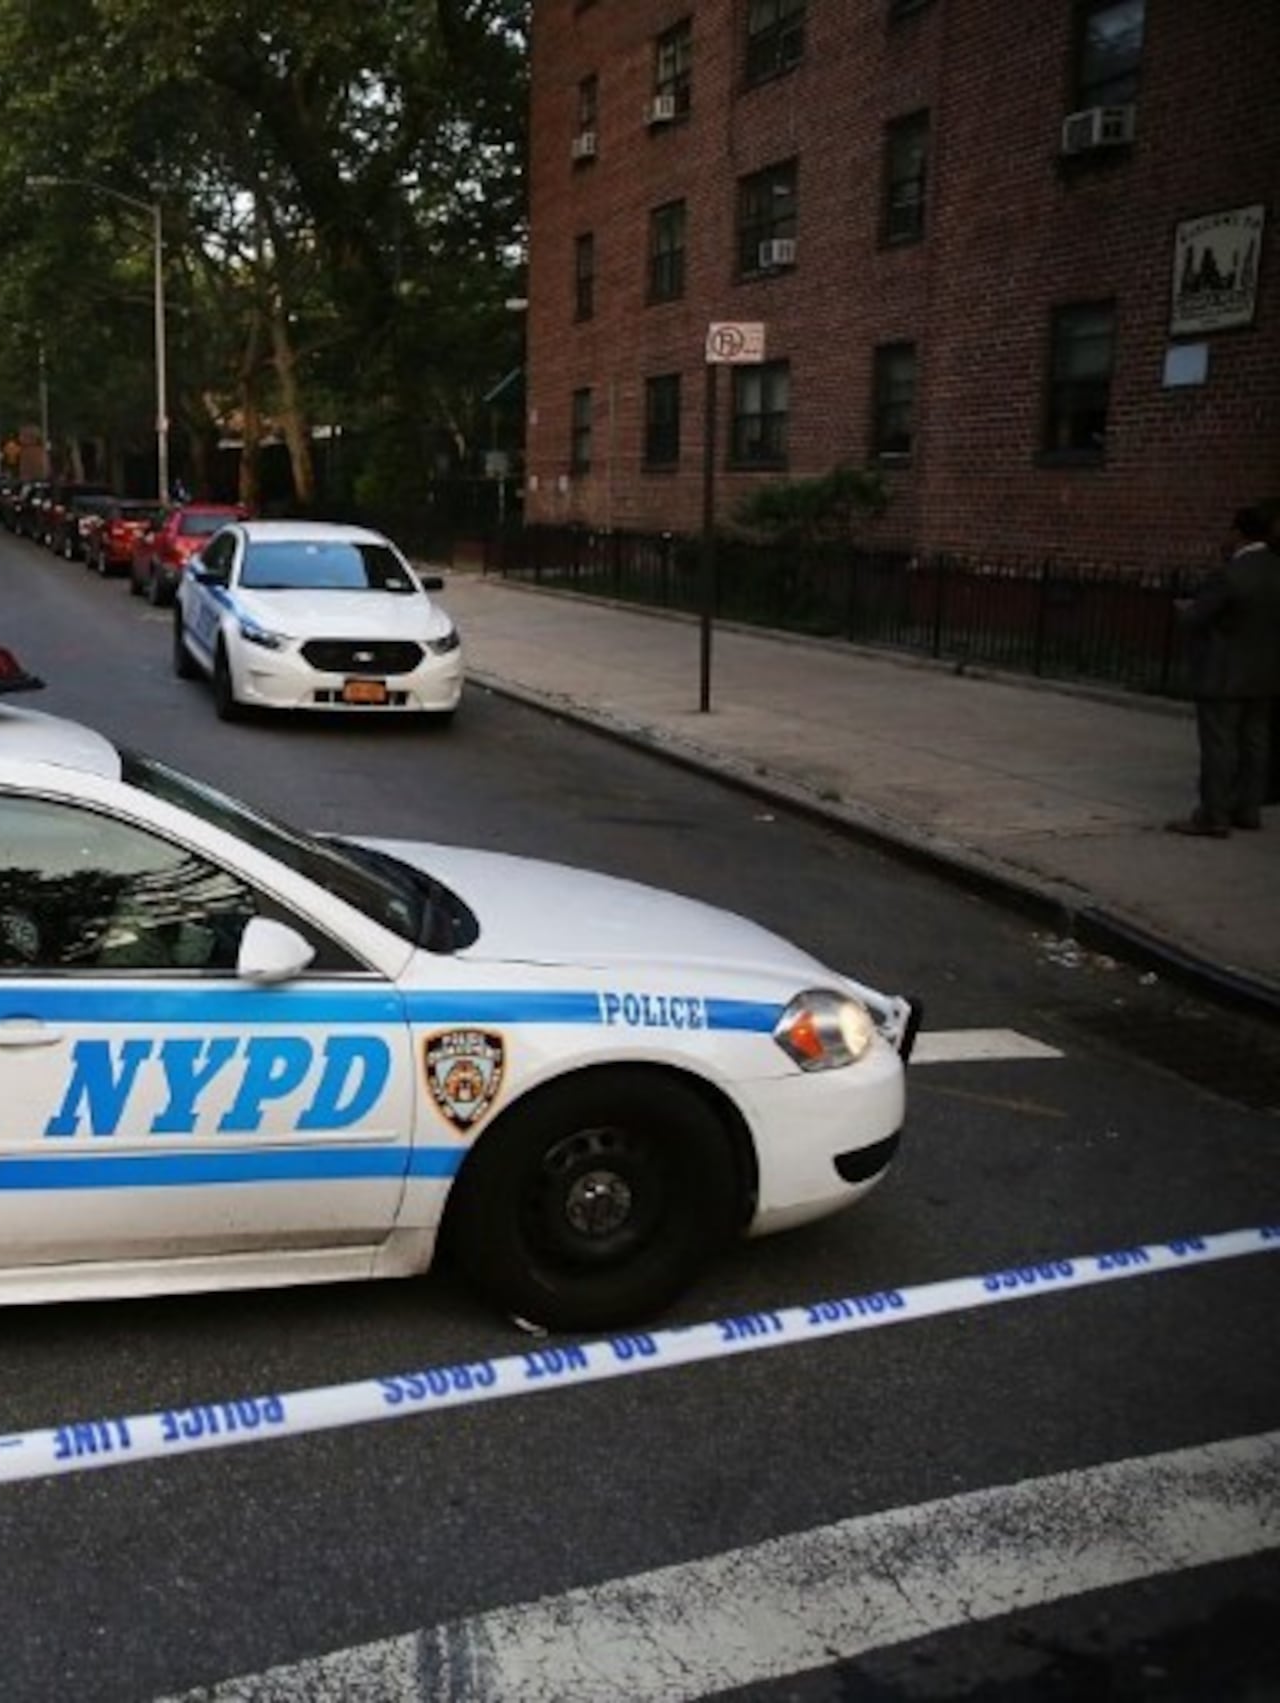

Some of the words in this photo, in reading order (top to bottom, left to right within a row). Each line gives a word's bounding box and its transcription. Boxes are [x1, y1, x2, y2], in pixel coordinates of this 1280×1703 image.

[603, 992, 702, 1030] POLICE
[44, 1035, 391, 1137] NYPD
[53, 1418, 131, 1460] LINE
[161, 1395, 285, 1442] POLICE
